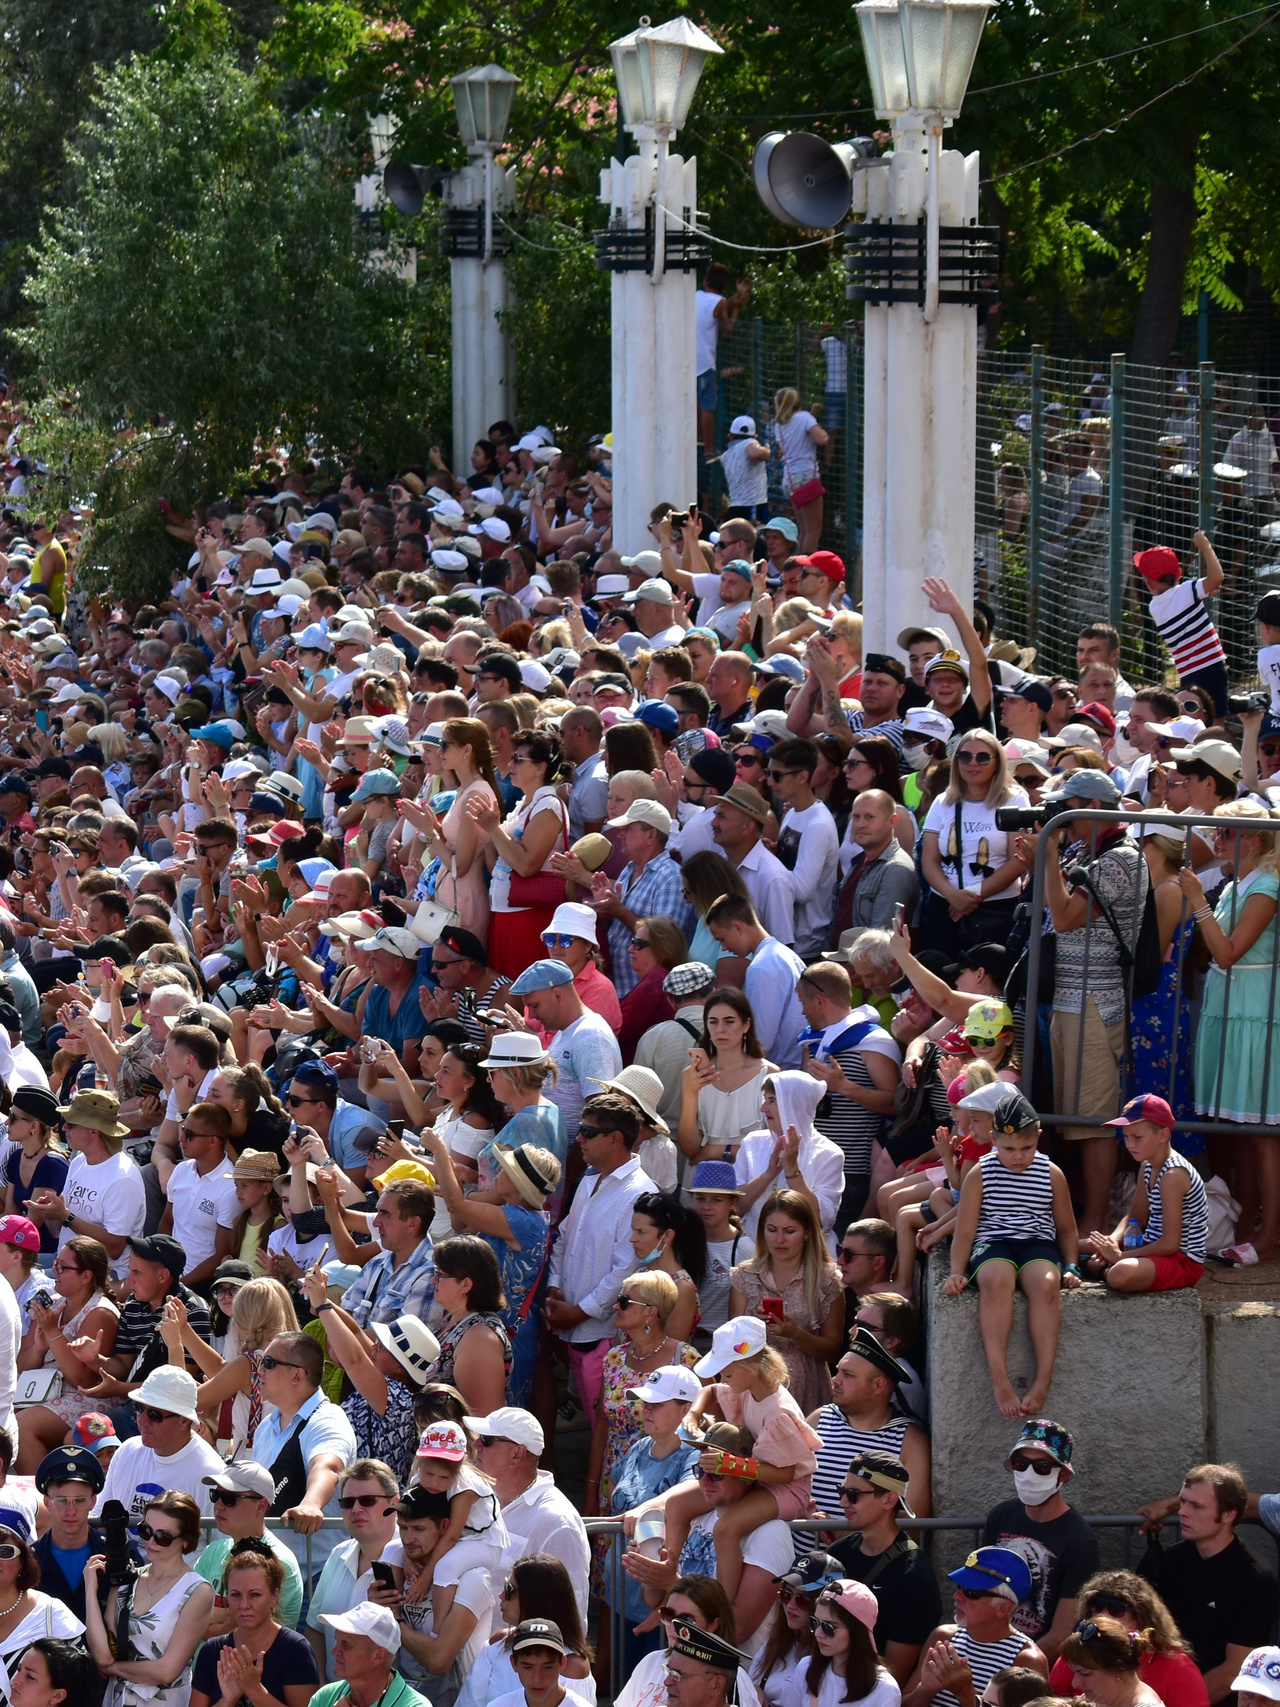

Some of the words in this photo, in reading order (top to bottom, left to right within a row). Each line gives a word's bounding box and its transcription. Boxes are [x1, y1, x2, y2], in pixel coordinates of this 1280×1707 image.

[69, 1180, 97, 1202] Marc
[273, 1476, 289, 1500] reme
[696, 1650, 713, 1661] ФЛОТ
